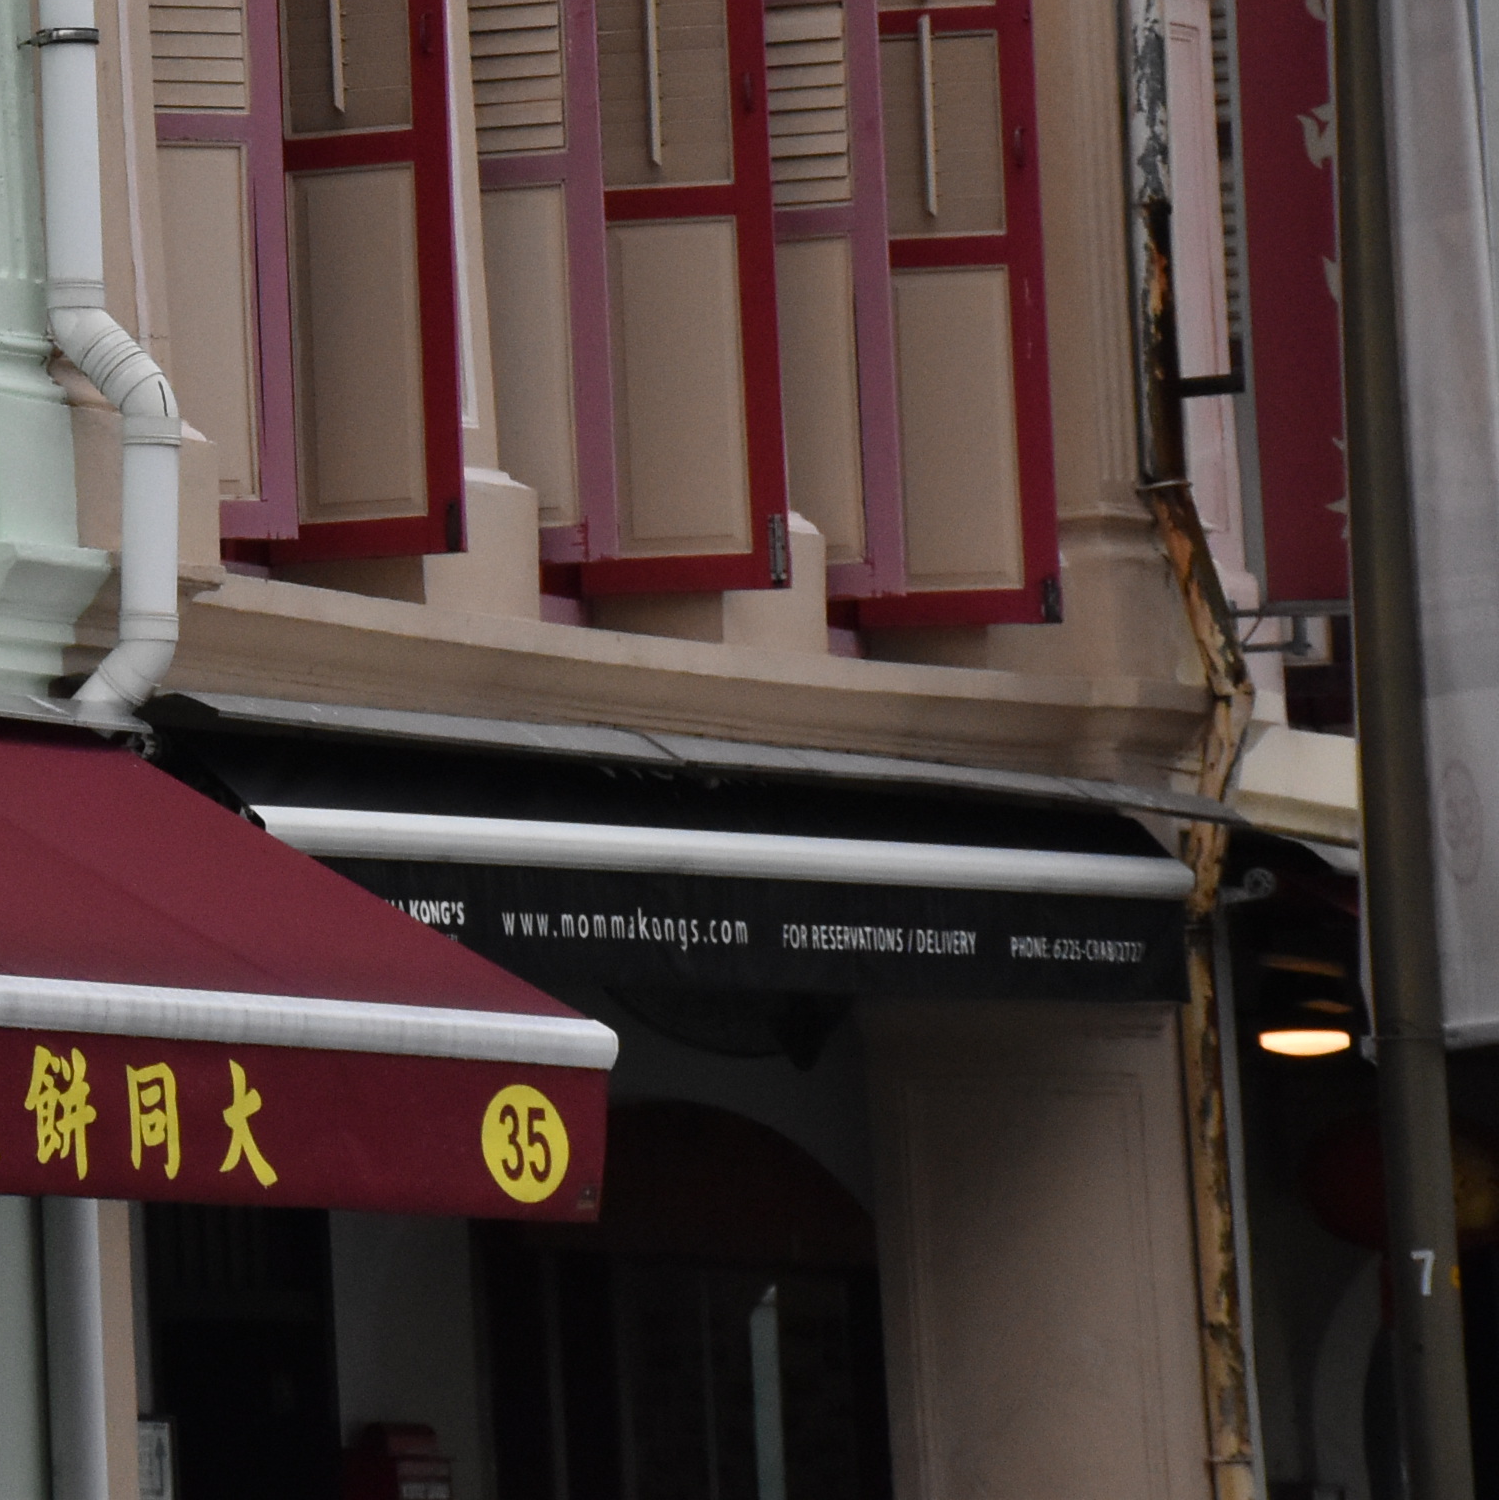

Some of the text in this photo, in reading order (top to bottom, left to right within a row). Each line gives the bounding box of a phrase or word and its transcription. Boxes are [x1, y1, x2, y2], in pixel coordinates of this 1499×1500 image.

[408, 899, 466, 926] KONG'S
[501, 906, 749, 952] www.mommakongs.com
[782, 923, 808, 949] FOR
[811, 924, 904, 953] RESERVATIONS
[916, 928, 977, 956] DELIVERY
[498, 1102, 553, 1184] 35
[1410, 1248, 1436, 1297] 7
